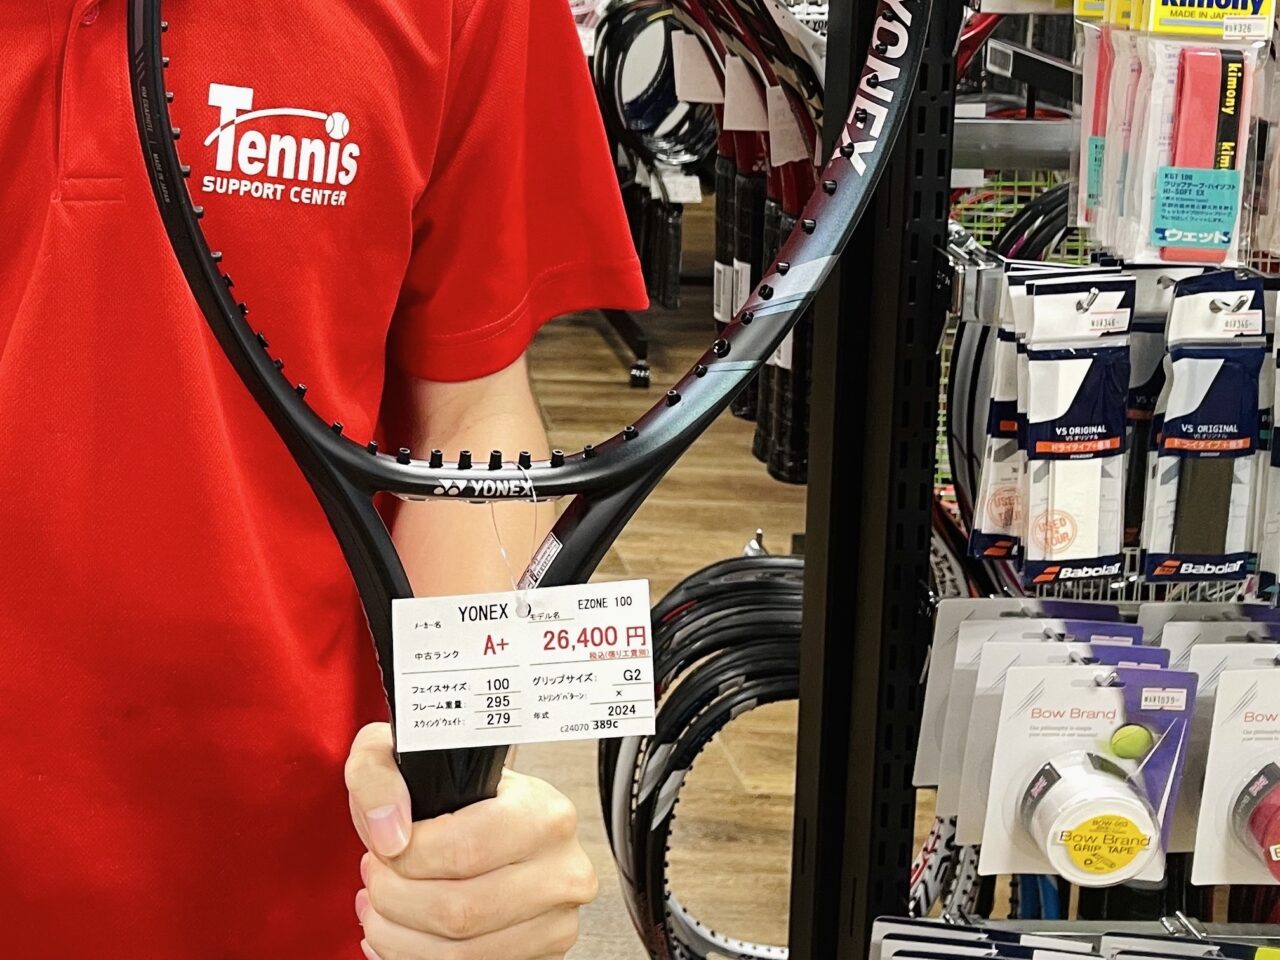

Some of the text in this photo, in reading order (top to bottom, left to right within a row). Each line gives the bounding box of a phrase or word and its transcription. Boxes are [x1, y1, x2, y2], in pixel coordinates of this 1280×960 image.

[1170, 9, 1196, 18] MADE
[1228, 62, 1243, 116] kimony
[207, 82, 361, 186] Tennis
[202, 176, 347, 206] SUPPORT CENTER
[1164, 228, 1229, 244] ウェット
[1056, 425, 1107, 436] VS ORIGINAL
[1182, 424, 1238, 433] VS ORIGINAL
[469, 478, 534, 497] YONEX
[578, 597, 608, 610] EZONE
[615, 595, 632, 607] 100
[458, 603, 508, 622] YONEX
[543, 625, 646, 652] 26,400 円
[414, 634, 510, 660] 中古ランク A+
[623, 668, 642, 681] G2
[486, 678, 510, 691] 100
[486, 695, 511, 709] 295
[608, 704, 637, 717] 2024
[1031, 707, 1117, 721] Bow Brand
[1244, 711, 1279, 723] Bow
[486, 712, 511, 726] 279
[592, 720, 619, 731] 389c
[1060, 830, 1151, 847] Bow Brand
[1073, 844, 1135, 855] GRIP TAPE
